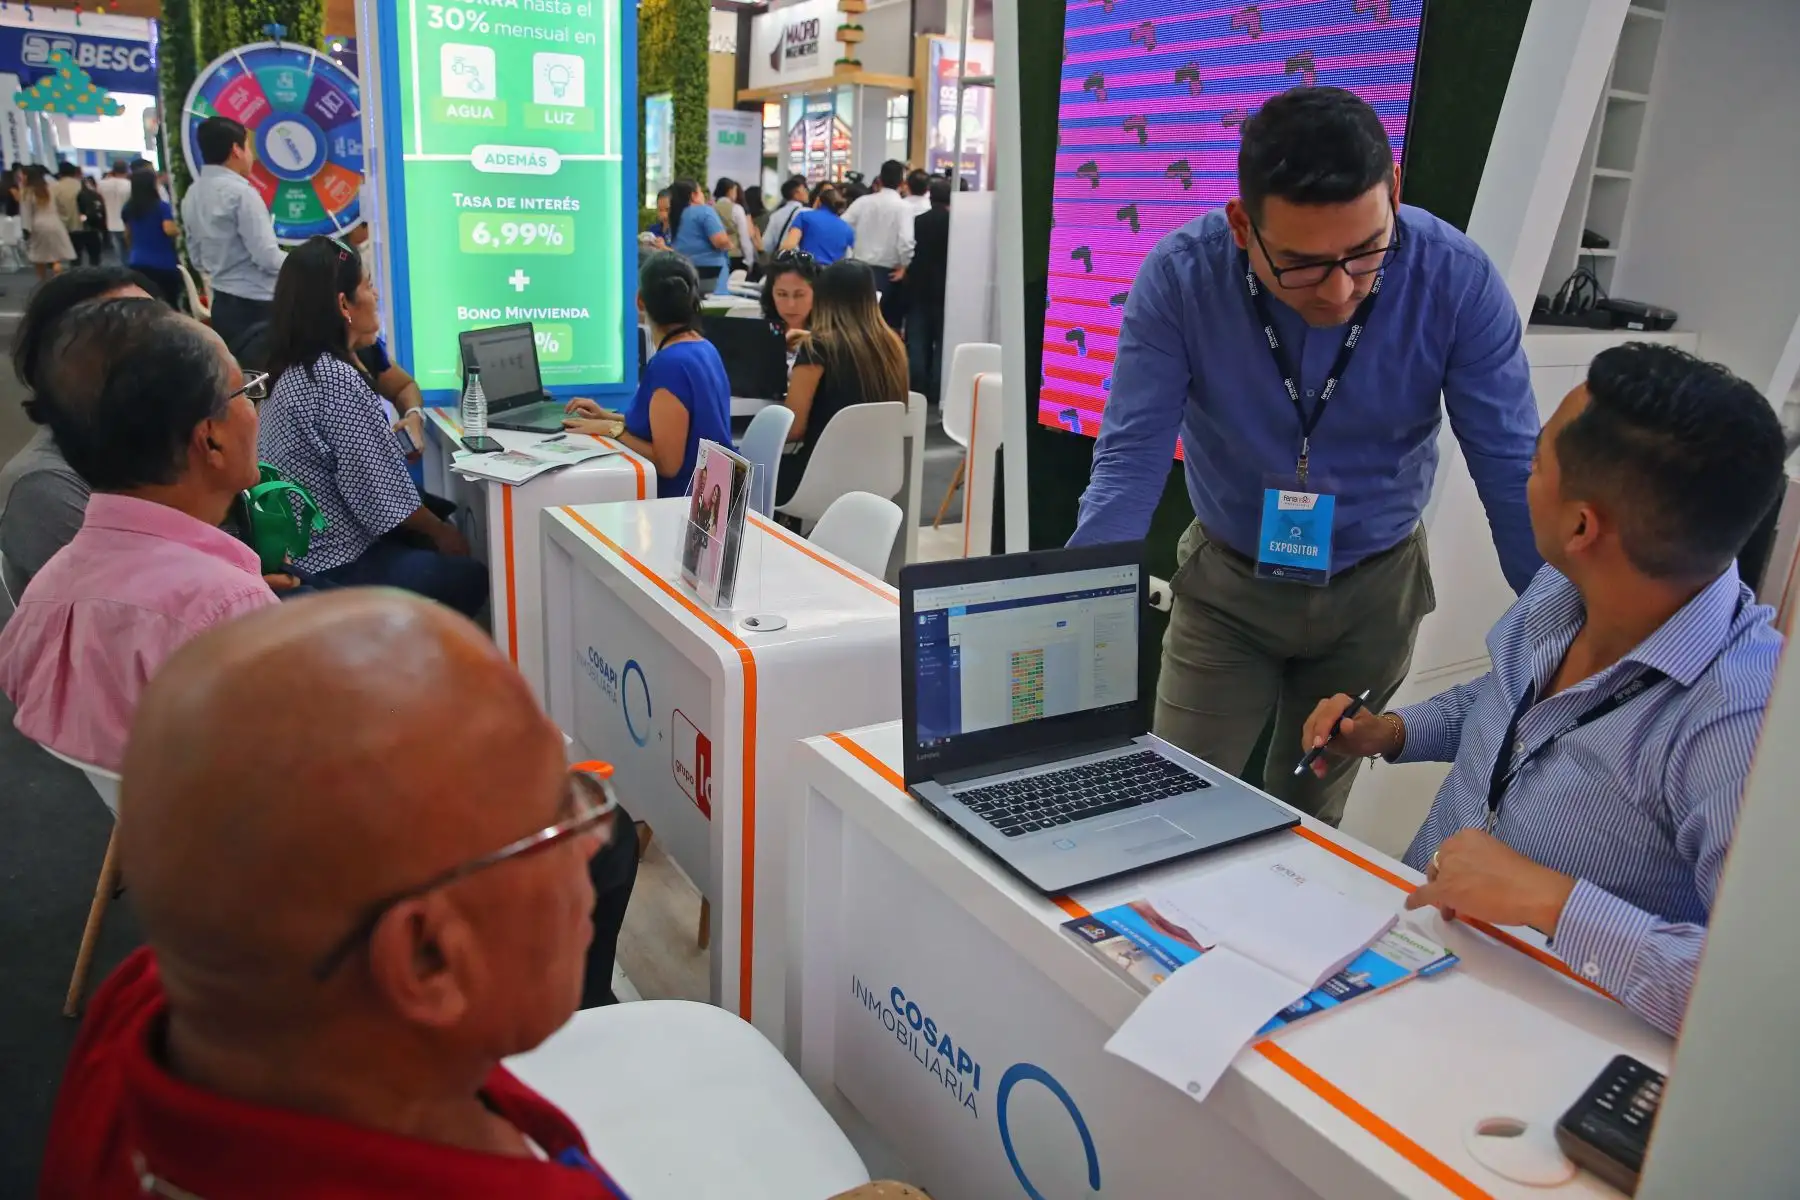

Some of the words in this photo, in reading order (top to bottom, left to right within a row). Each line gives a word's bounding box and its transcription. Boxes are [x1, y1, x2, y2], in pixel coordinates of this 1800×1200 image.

[577, 0, 592, 17] el
[427, 4, 490, 33] 30%
[494, 22, 569, 42] mensual
[575, 31, 596, 45] en
[446, 104, 494, 120] AGUA
[544, 109, 576, 126] LUZ
[484, 151, 548, 168] ADEMÁS
[1269, 541, 1319, 557] EXPOSITOR
[588, 645, 617, 690] COSAPI
[675, 759, 695, 785] grupo
[851, 974, 980, 1119] INMOBILIARIA
[890, 985, 981, 1092] COSAPI
